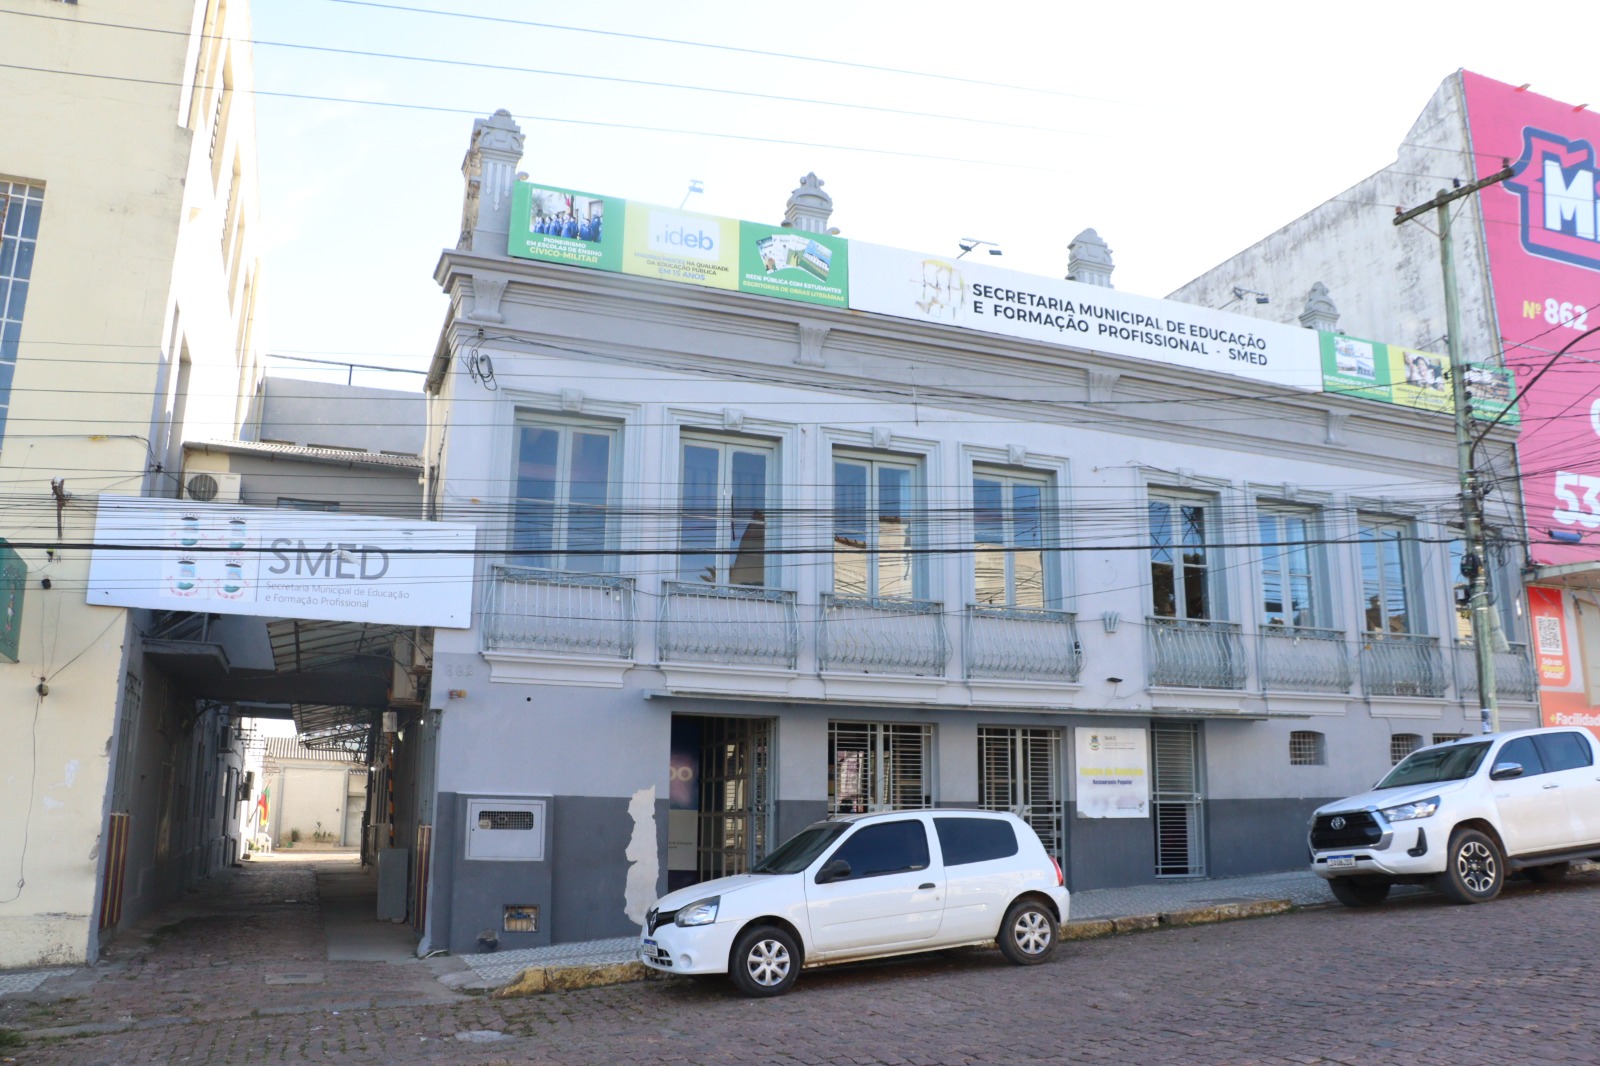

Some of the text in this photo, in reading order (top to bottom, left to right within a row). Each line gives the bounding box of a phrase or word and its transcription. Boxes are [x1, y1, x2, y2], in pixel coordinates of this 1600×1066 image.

[544, 236, 586, 248] PIONEIRISMO
[665, 223, 714, 251] ideb
[537, 242, 567, 251] ESCOLAS
[578, 248, 602, 256] ENSINO
[657, 262, 690, 272] EDUCAÇÃO
[692, 266, 716, 276] PÚBLICA
[696, 262, 729, 272] QUALIDADE
[682, 272, 706, 280] ANOS
[742, 280, 780, 292] ESCRITORES
[790, 288, 810, 296] OBRAS
[763, 276, 788, 286] PÚBLICA
[804, 283, 842, 294] ESTUDANTES
[972, 283, 1267, 350] SECRETARIA MUNICIPAL DE EDUCAÇÃO
[1544, 297, 1588, 332] 862
[973, 300, 984, 314] E
[993, 304, 1089, 333] FORMAÇÃO
[1097, 322, 1209, 355] PROFISSIONAL
[1228, 348, 1268, 366] SMED
[268, 537, 390, 580] SMED
[266, 581, 410, 600] Secretaria Municipal de Educação
[273, 594, 318, 606] Formação
[320, 596, 369, 608] Profissional
